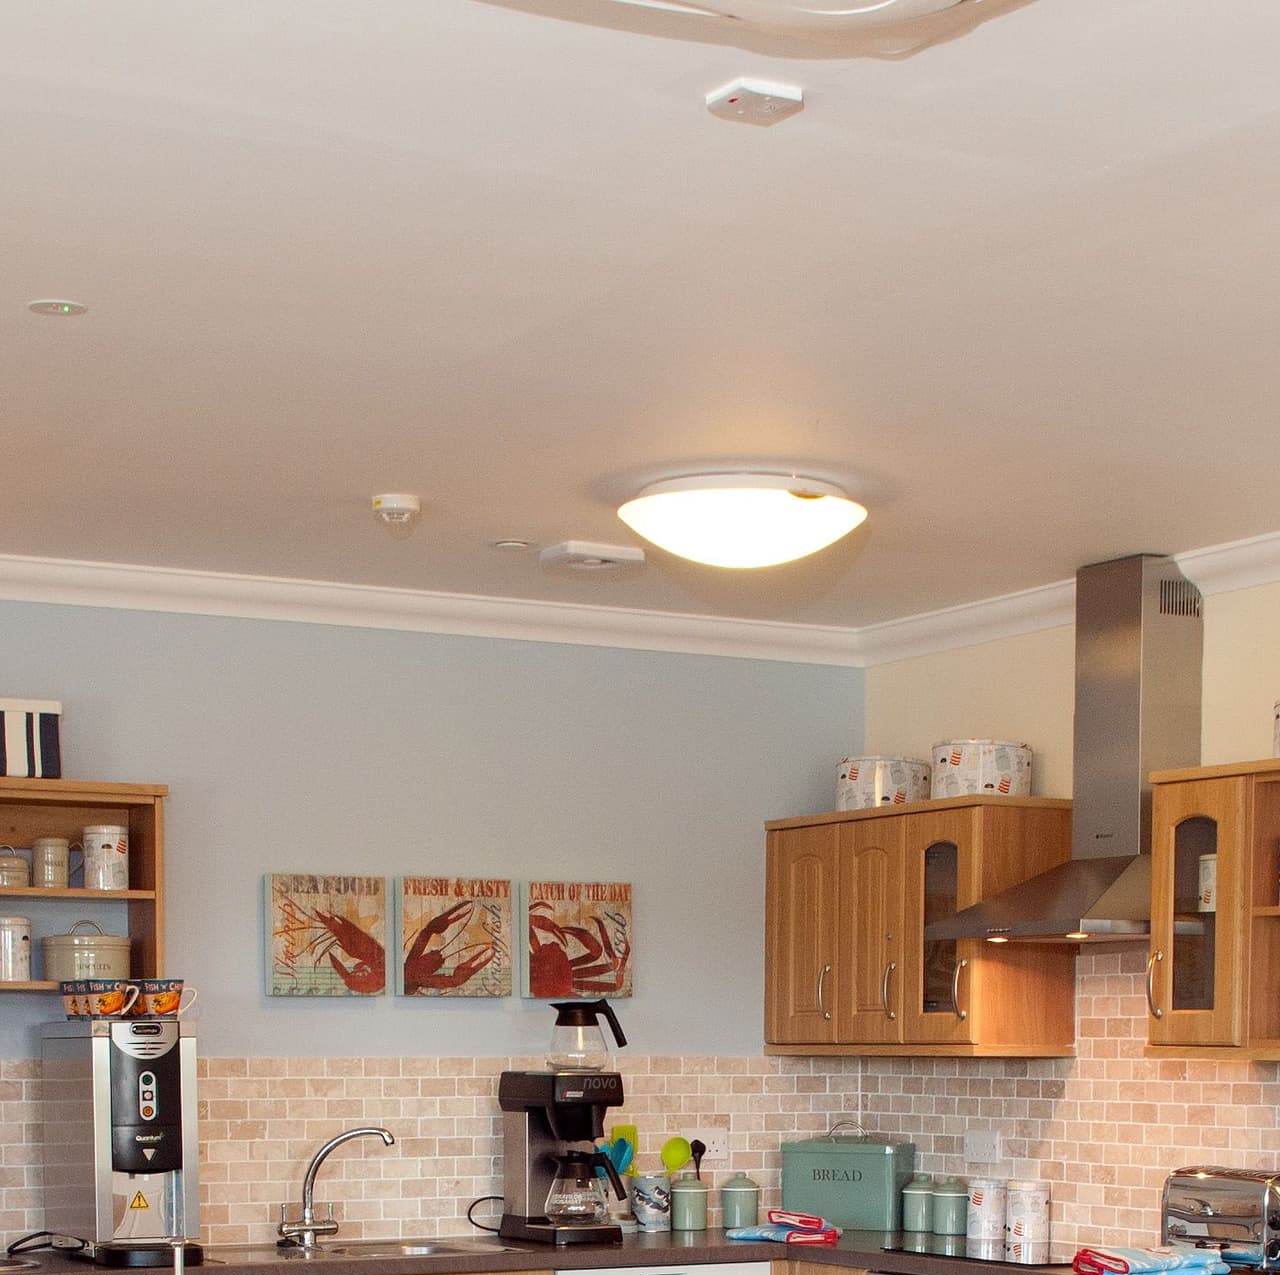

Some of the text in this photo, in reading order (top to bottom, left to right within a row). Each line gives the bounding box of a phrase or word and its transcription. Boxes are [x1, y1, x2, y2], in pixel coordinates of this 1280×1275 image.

[278, 875, 380, 896] SEAFOOD
[404, 878, 511, 898] FRESH & TASTY
[530, 883, 632, 902] CATCH OF THE DAY
[583, 1078, 617, 1089] novo
[812, 1168, 863, 1182] BREAD
